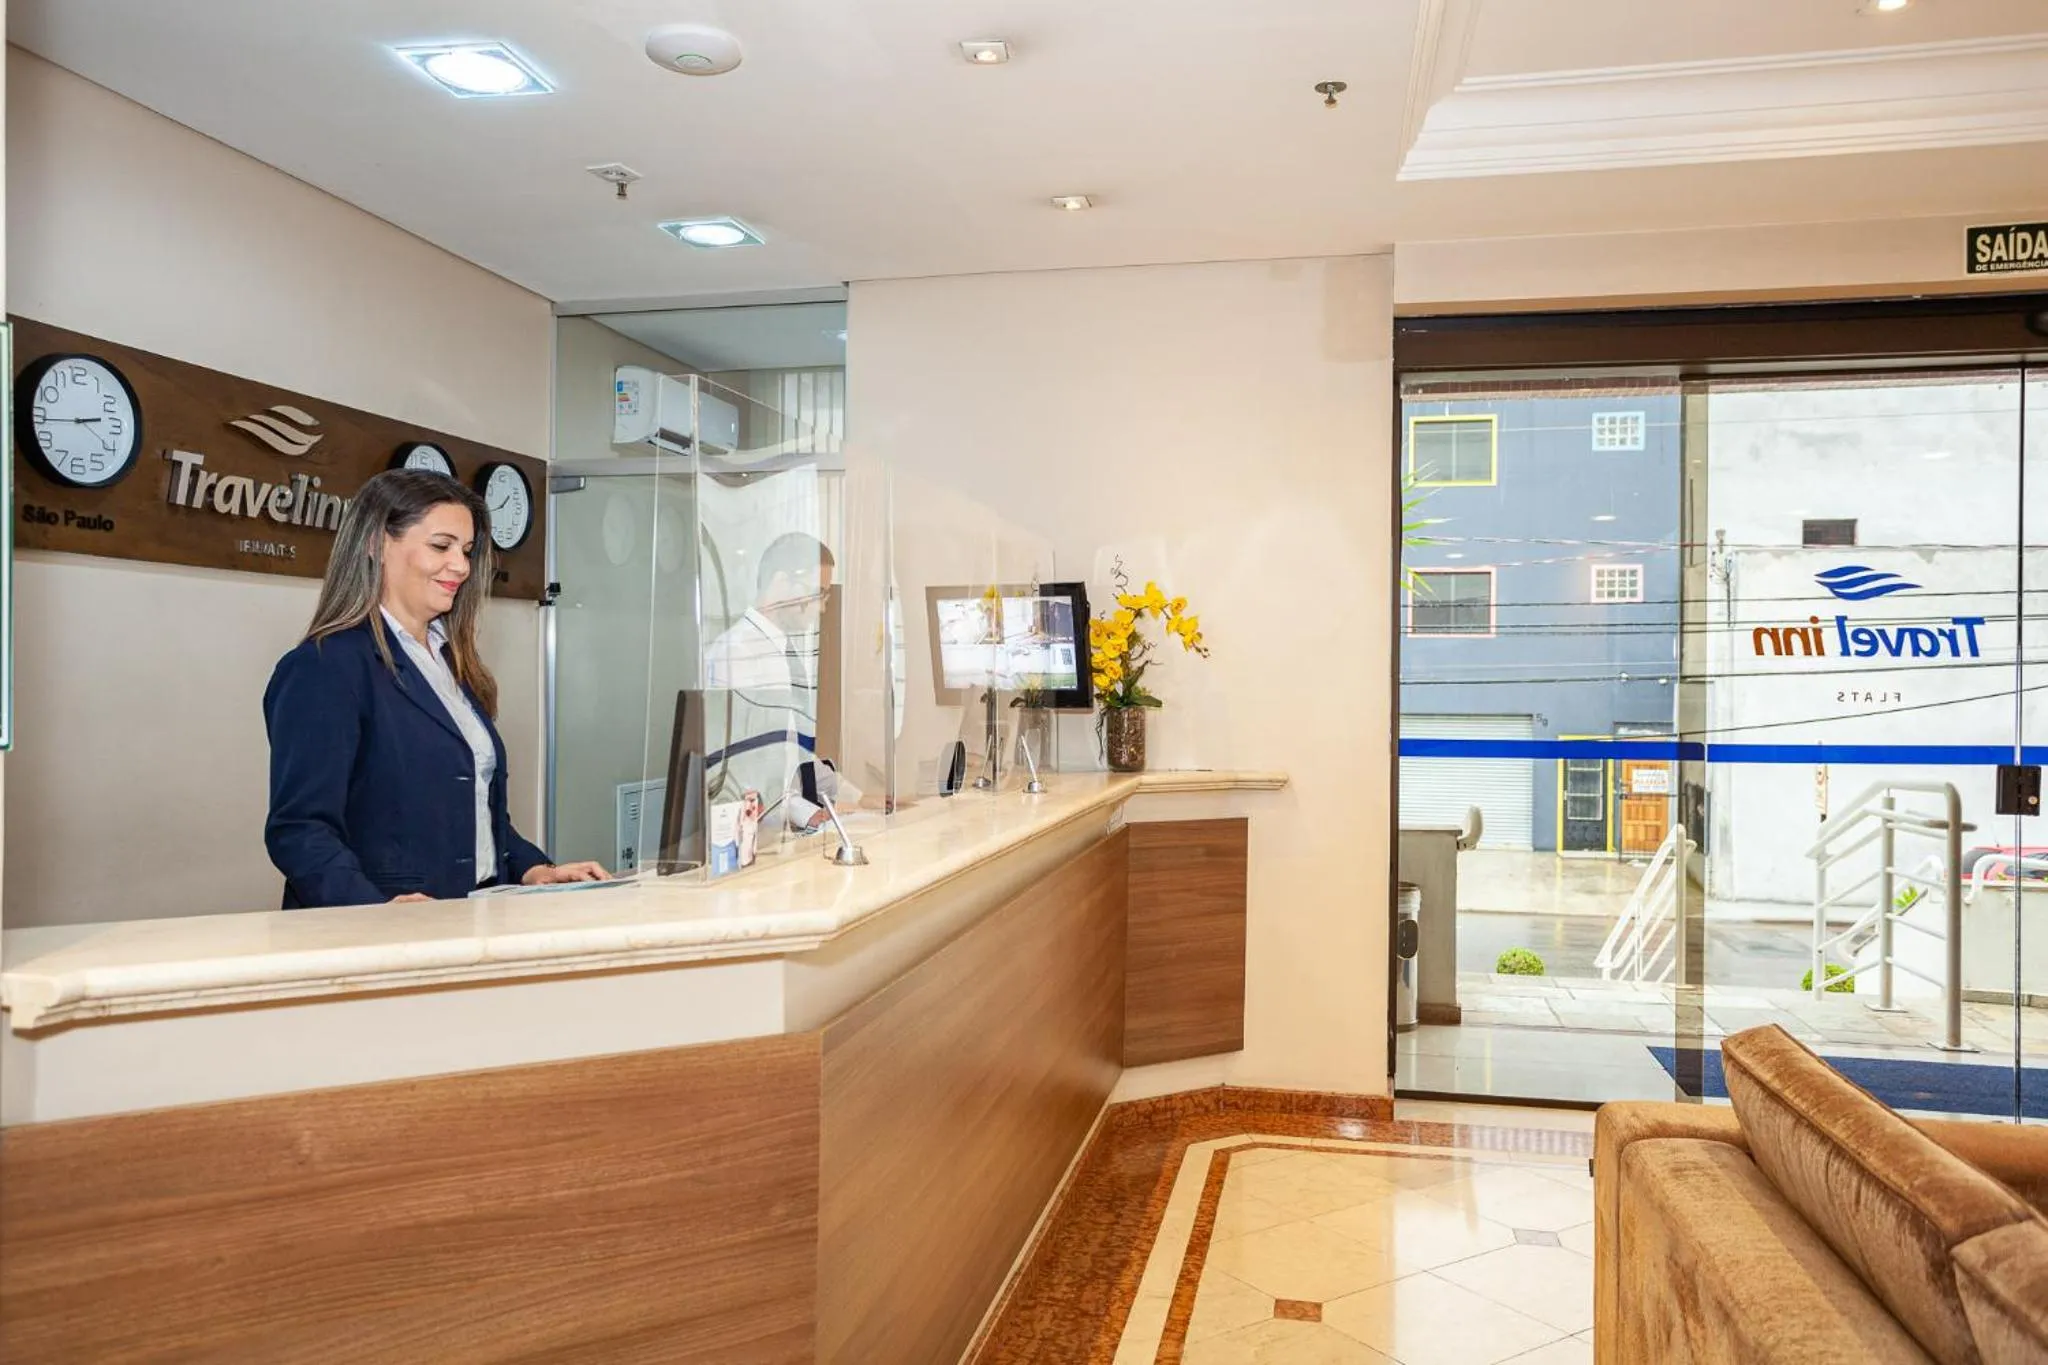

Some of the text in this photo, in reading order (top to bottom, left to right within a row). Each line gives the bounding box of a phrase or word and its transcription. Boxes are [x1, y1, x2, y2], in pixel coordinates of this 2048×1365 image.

[1976, 226, 2048, 263] SAÍDA
[53, 368, 66, 388] 11
[69, 366, 87, 386] 12
[40, 385, 59, 404] 10
[103, 394, 116, 413] 2
[109, 417, 122, 435] 3
[55, 449, 69, 467] 7
[71, 457, 86, 475] 6
[90, 453, 104, 471] 5
[22, 503, 115, 532] São Paulo
